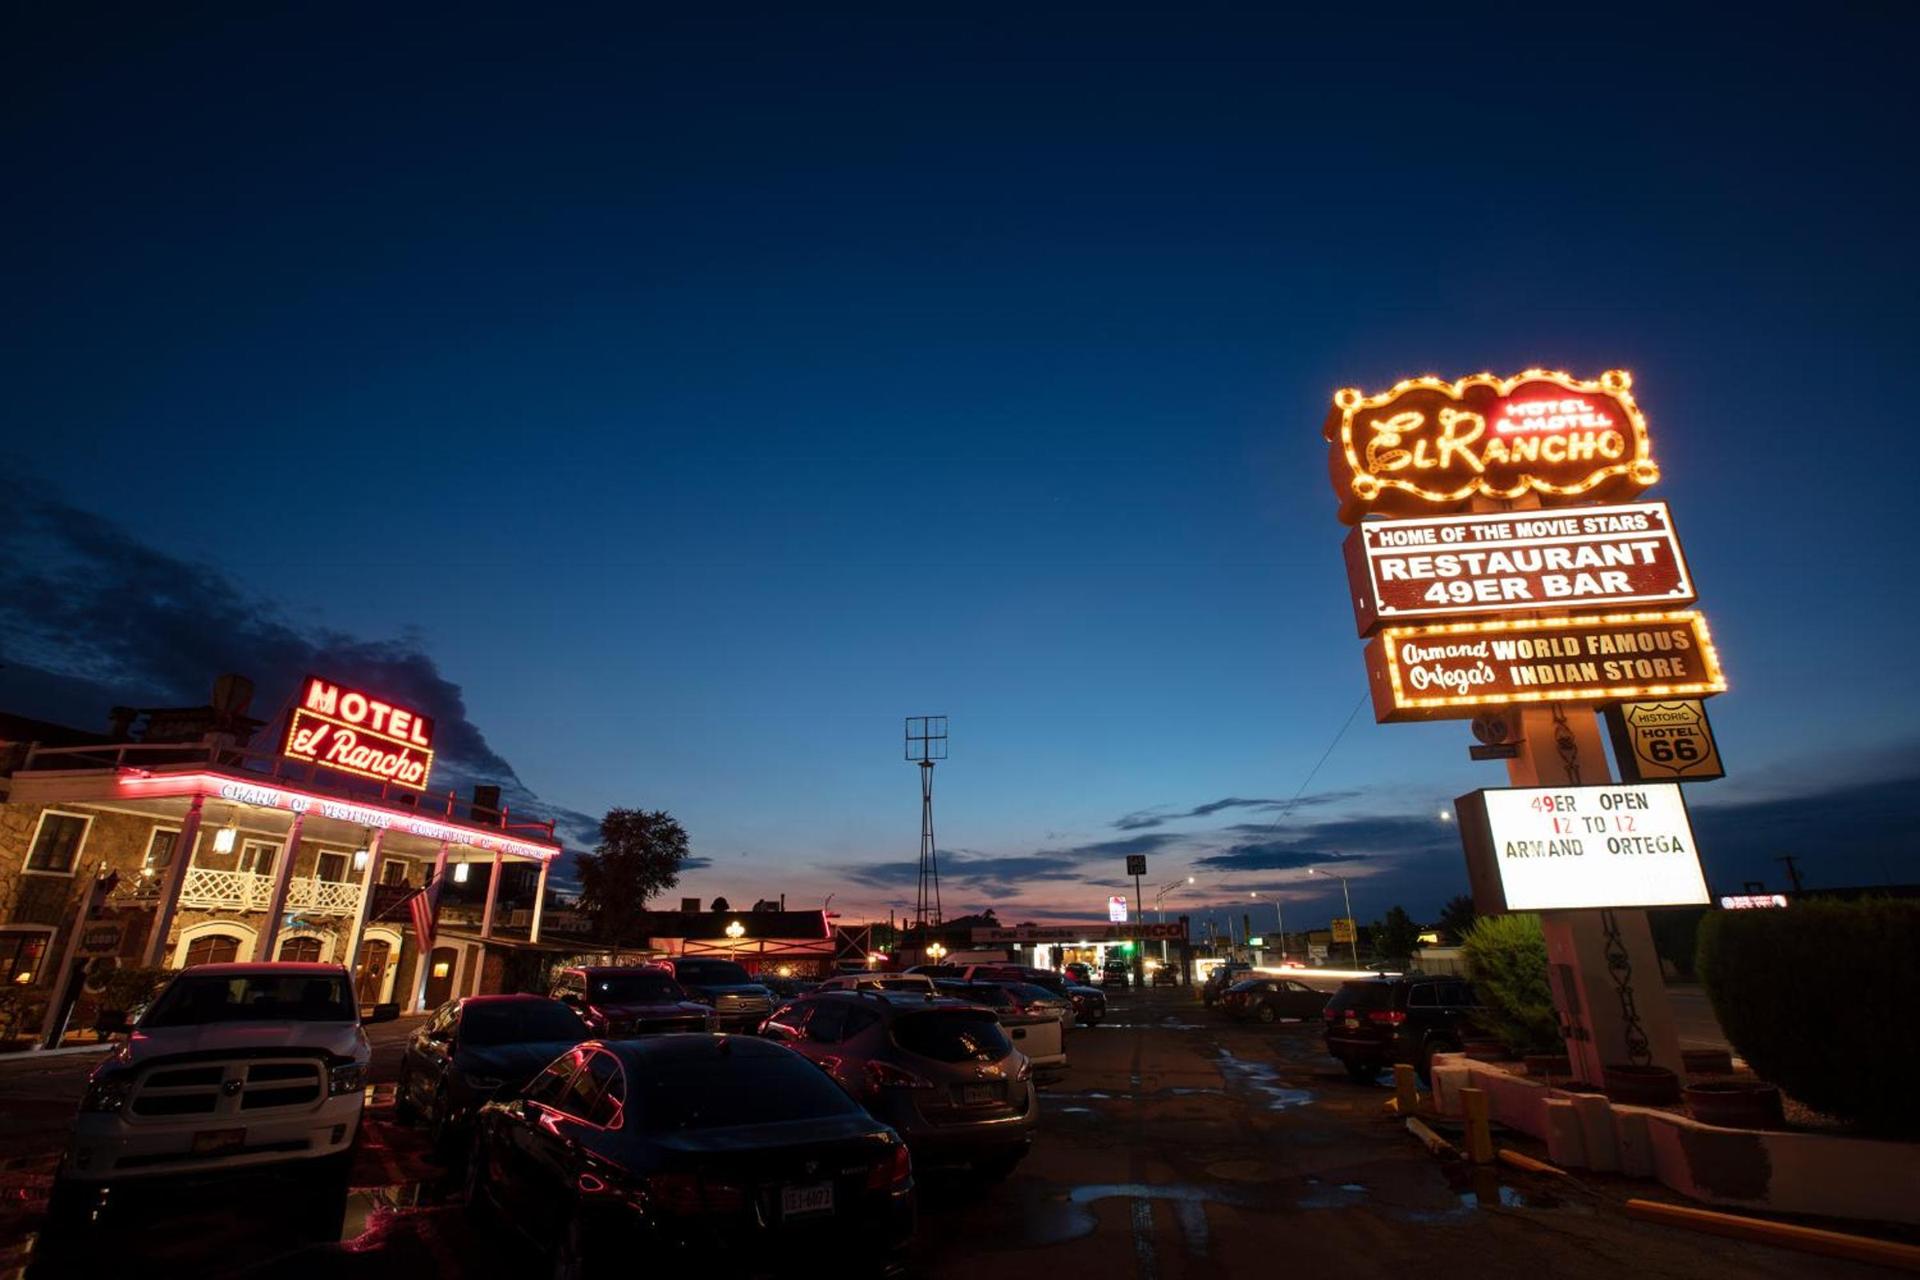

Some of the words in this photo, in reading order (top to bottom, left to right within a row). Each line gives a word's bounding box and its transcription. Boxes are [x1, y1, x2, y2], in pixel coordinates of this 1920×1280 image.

[1505, 399, 1594, 416] HOTEL
[1436, 408, 1625, 473] RANCHO
[1379, 527, 1437, 547] HOME
[1441, 524, 1467, 543] OF
[1471, 521, 1513, 541] THE
[1516, 517, 1580, 537] MOVIE
[1583, 514, 1649, 534] STARS
[1379, 541, 1660, 582] RESTAURANT
[1424, 576, 1538, 605] 49ER
[1541, 570, 1636, 598] BAR
[1401, 641, 1489, 665] Armand
[1490, 636, 1581, 661] WORLD
[1585, 630, 1692, 655] FAMOUS
[1409, 661, 1496, 695] Ortega's
[1509, 662, 1599, 686] INDIAN
[1603, 657, 1688, 681] STORE
[305, 679, 428, 746] MOTEL
[1638, 712, 1690, 723] HISTORIC
[1641, 727, 1699, 739] HOTEL
[326, 729, 425, 782] Rancho
[1649, 738, 1698, 762] 66
[1531, 795, 1577, 813] 49ER
[1599, 792, 1650, 811] OPEN
[1553, 817, 1573, 834] 12
[1581, 816, 1607, 834] TO
[1615, 815, 1637, 832] 12
[1506, 839, 1584, 859] ARMAND
[1607, 835, 1686, 854] ORTEGA
